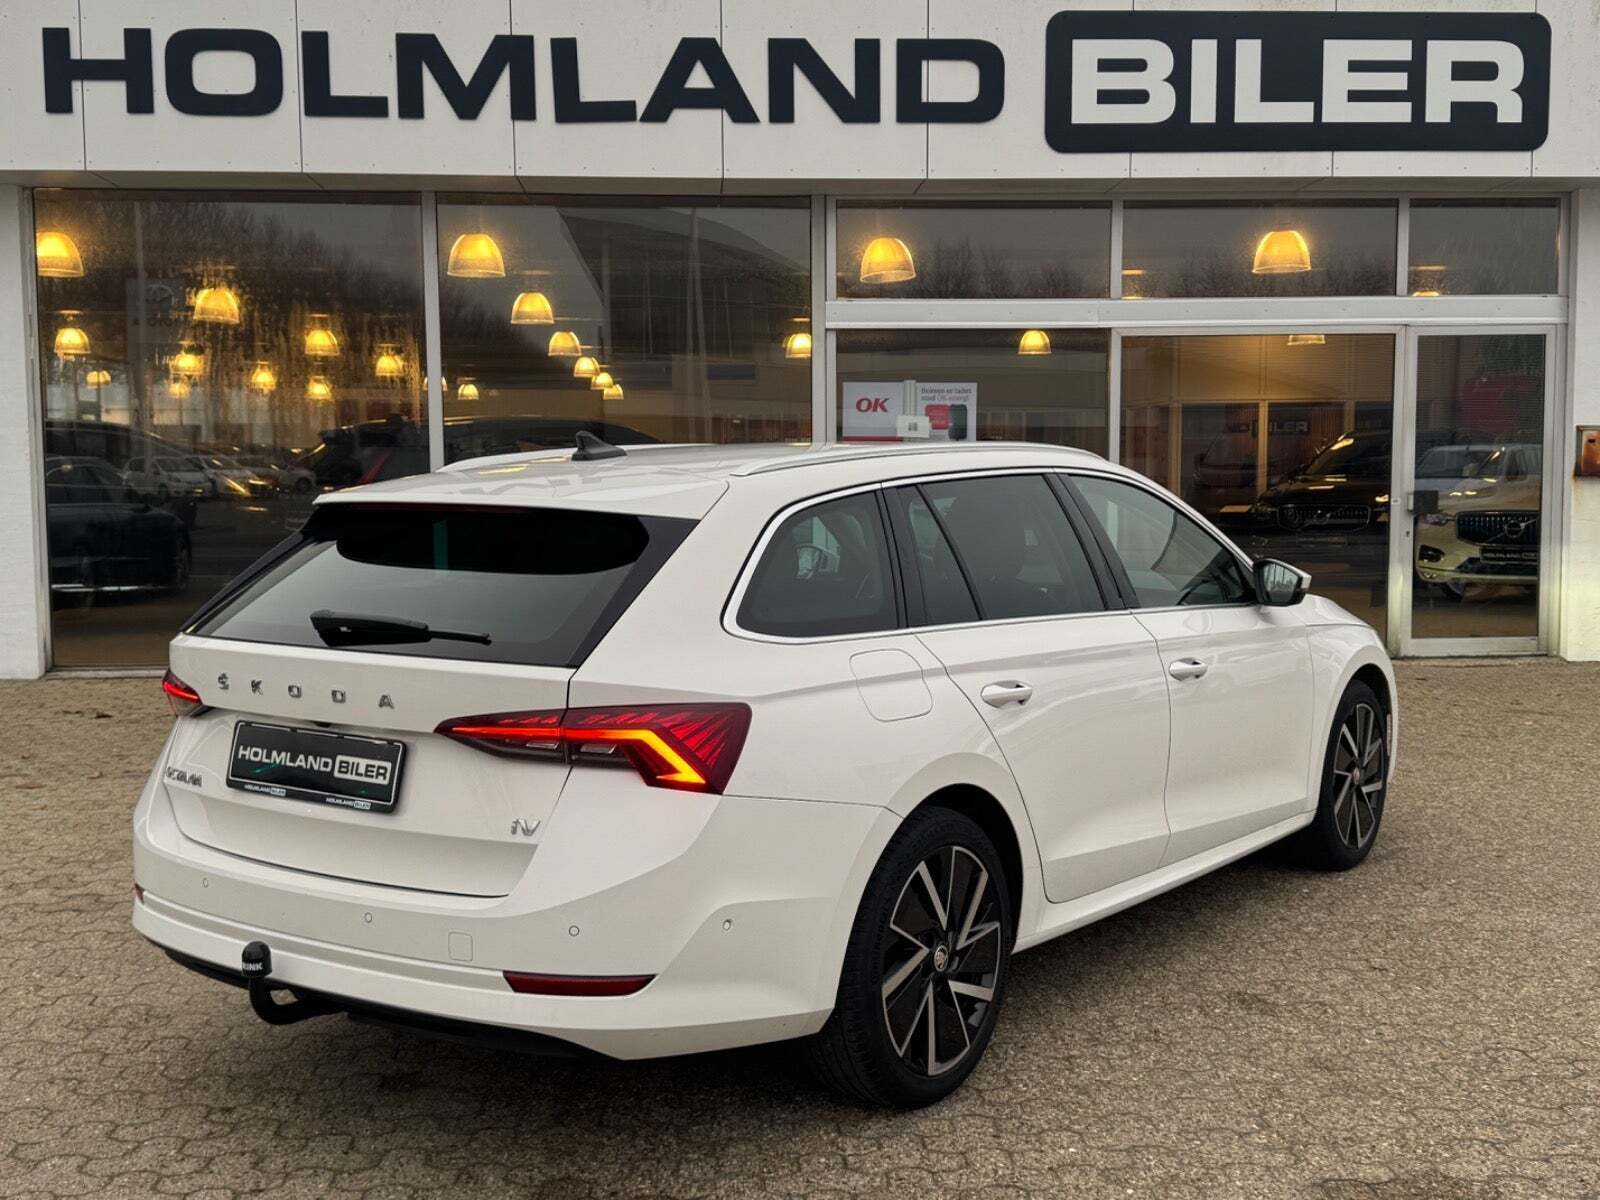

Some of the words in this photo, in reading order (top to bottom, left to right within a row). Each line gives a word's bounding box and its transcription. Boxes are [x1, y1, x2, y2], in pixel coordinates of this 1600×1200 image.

[42, 27, 1006, 124] HOLMLAND
[1070, 38, 1526, 125] BILER
[855, 397, 890, 413] OK
[238, 745, 333, 772] HOLMLAND
[337, 759, 389, 781] BILER
